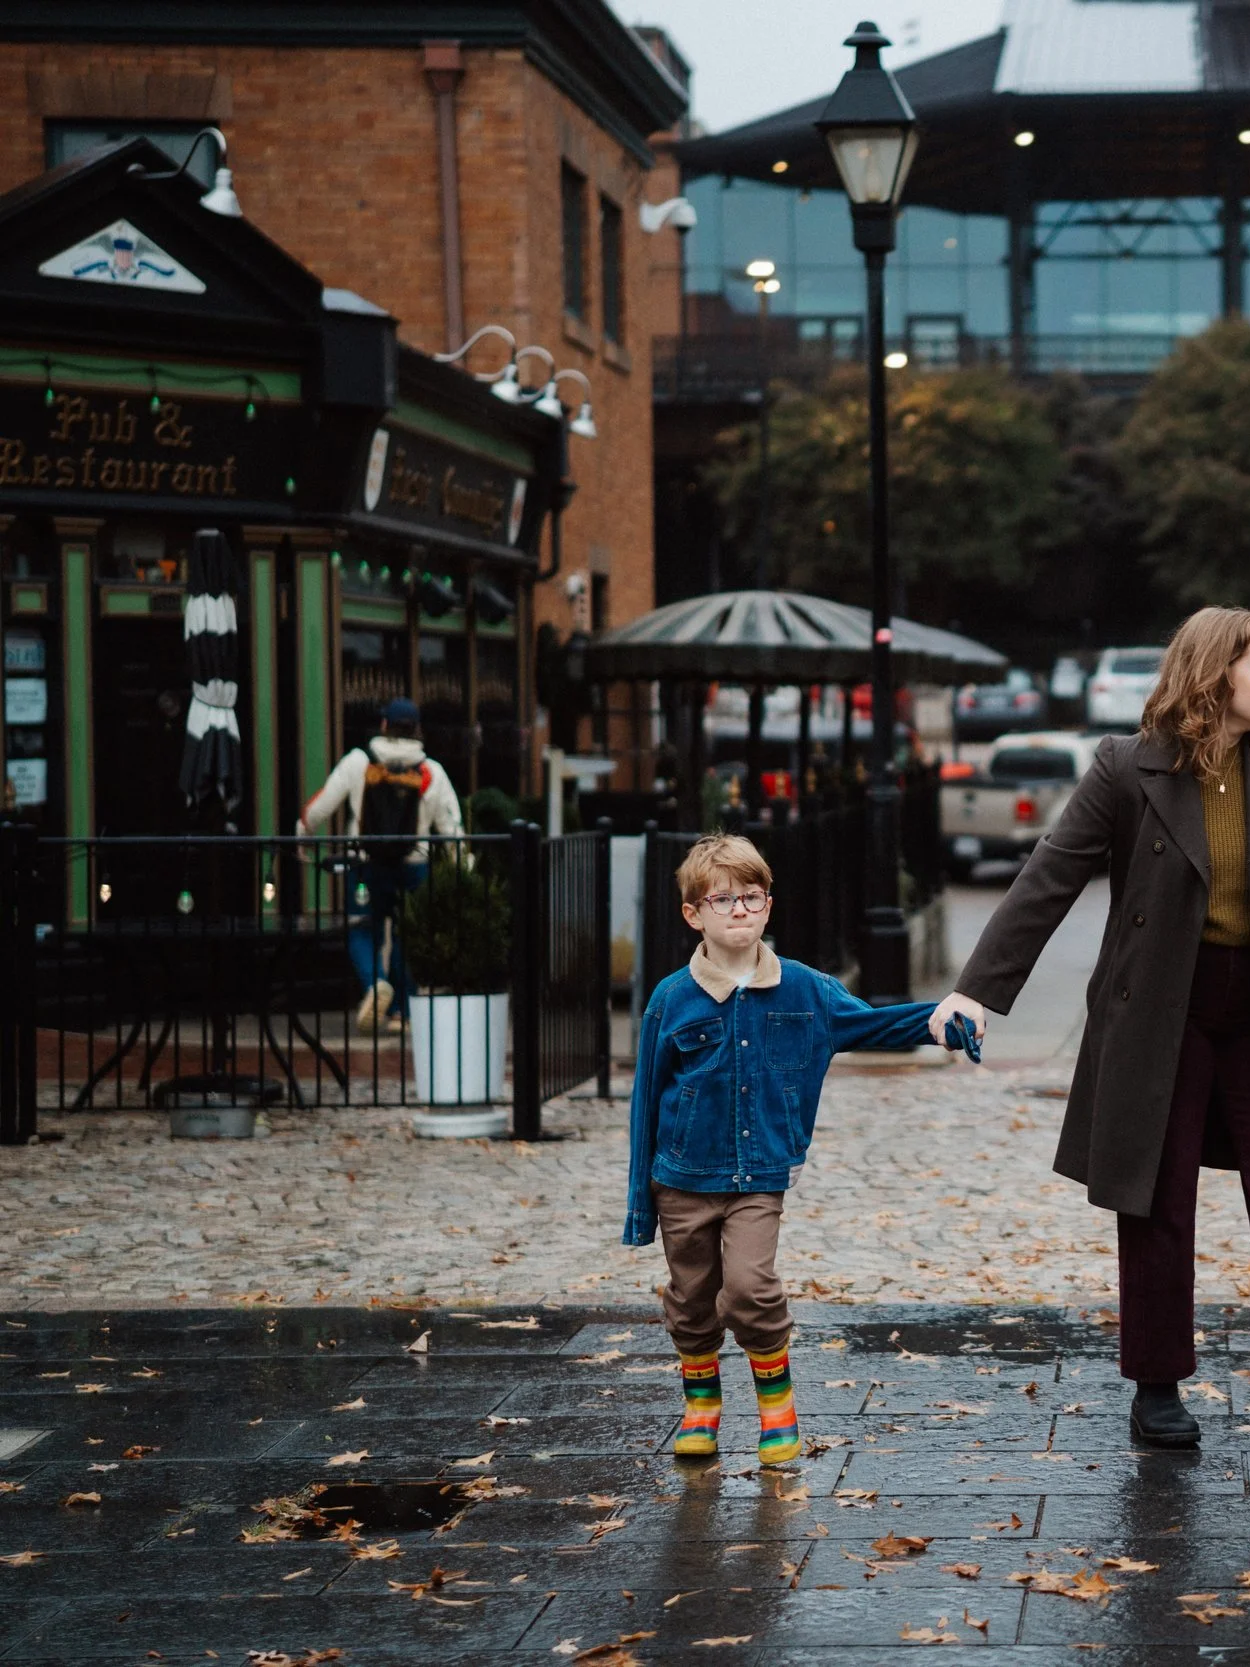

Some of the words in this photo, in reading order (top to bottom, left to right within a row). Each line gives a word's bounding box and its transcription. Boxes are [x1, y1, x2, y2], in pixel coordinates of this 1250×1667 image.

[50, 393, 137, 444] Pub
[154, 402, 193, 448] &
[0, 437, 238, 495] Restaurant
